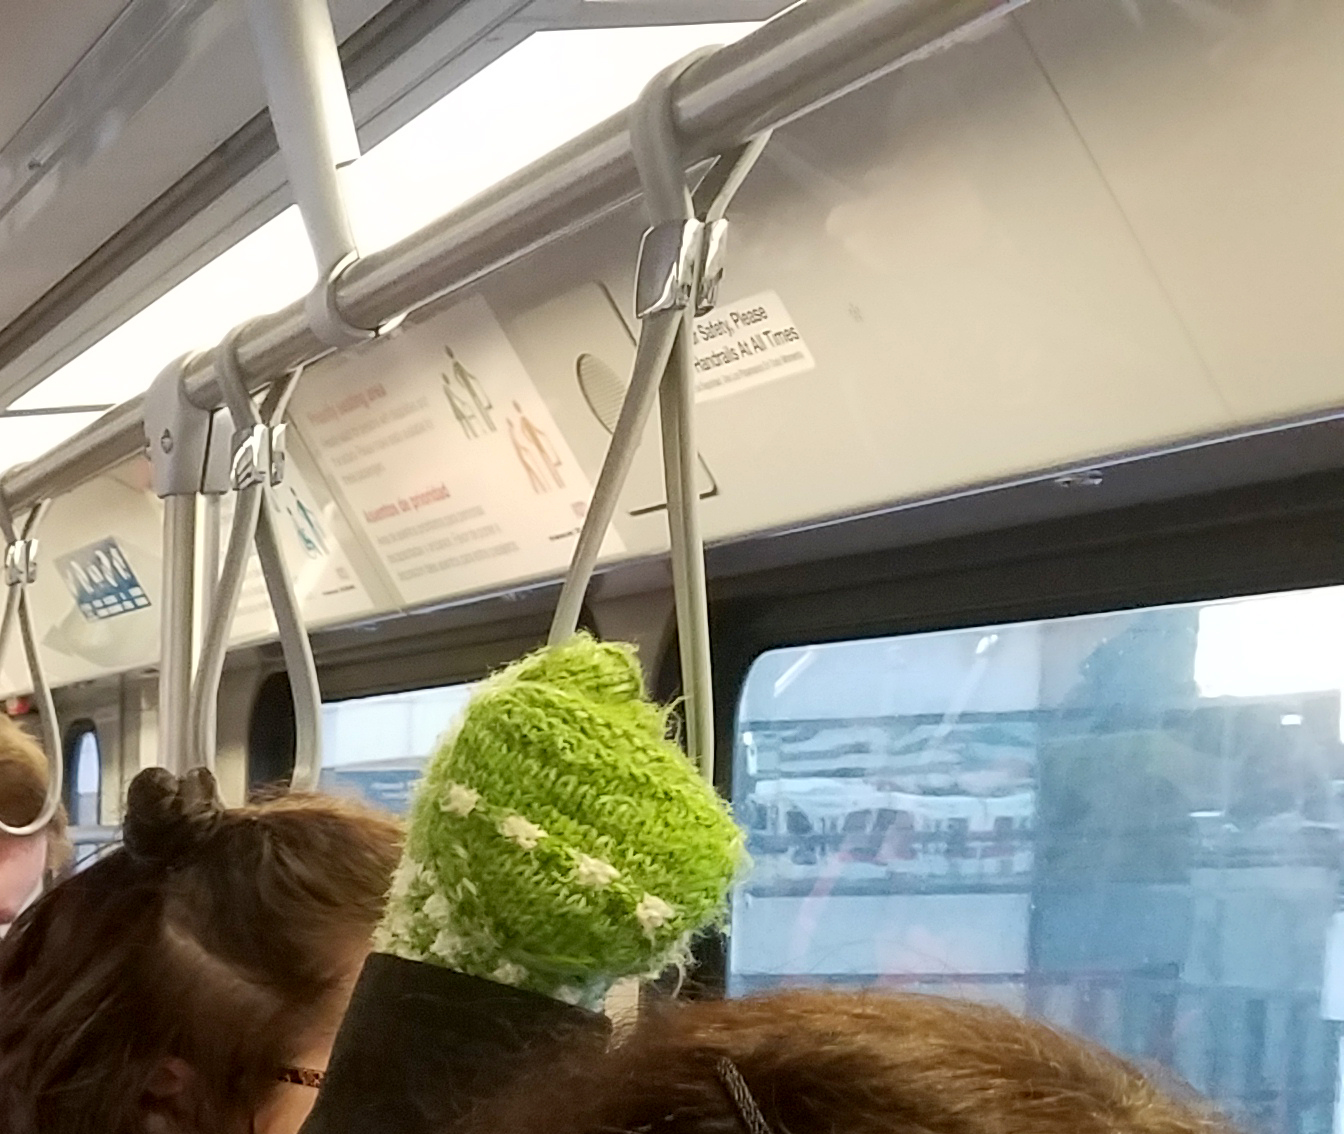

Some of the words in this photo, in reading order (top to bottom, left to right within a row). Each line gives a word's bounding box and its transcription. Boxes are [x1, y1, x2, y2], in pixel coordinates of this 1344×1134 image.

[697, 320, 734, 340] Safety,
[729, 307, 767, 328] Please
[737, 340, 753, 357] At
[750, 334, 767, 353] All
[762, 327, 799, 346] Times
